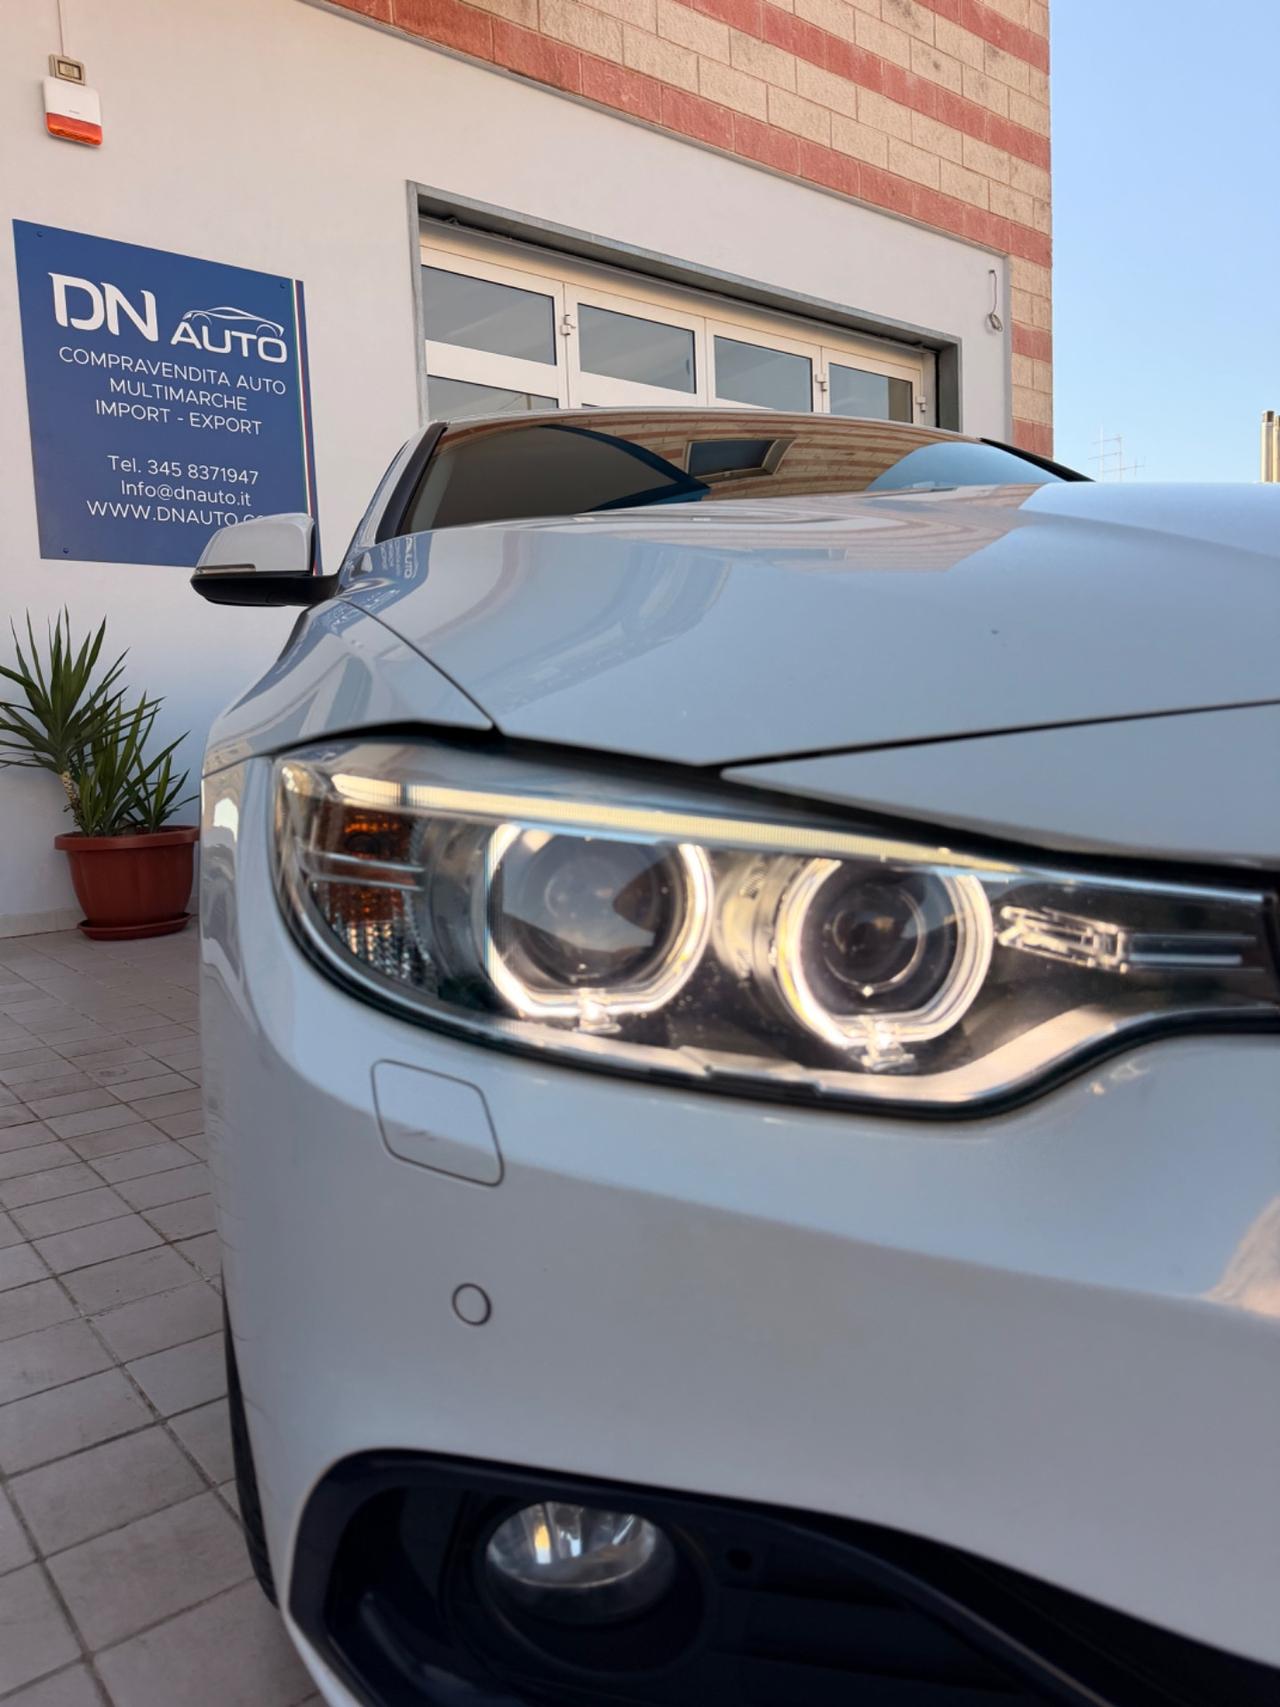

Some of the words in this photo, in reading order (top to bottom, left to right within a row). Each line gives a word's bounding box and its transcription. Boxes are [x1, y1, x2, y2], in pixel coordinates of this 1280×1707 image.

[48, 272, 158, 341] DN
[171, 321, 287, 363] AUTO
[59, 346, 230, 387] COMPRAVENDITA
[236, 375, 286, 395] AUTO
[110, 377, 247, 412] MULTIMARCHE
[95, 400, 171, 423] IMPORT
[190, 412, 262, 435] EXPORT
[107, 455, 142, 474] Tel.
[147, 459, 182, 477] 345
[188, 464, 259, 485] 8371947
[121, 480, 252, 507] Info@dnauto.it
